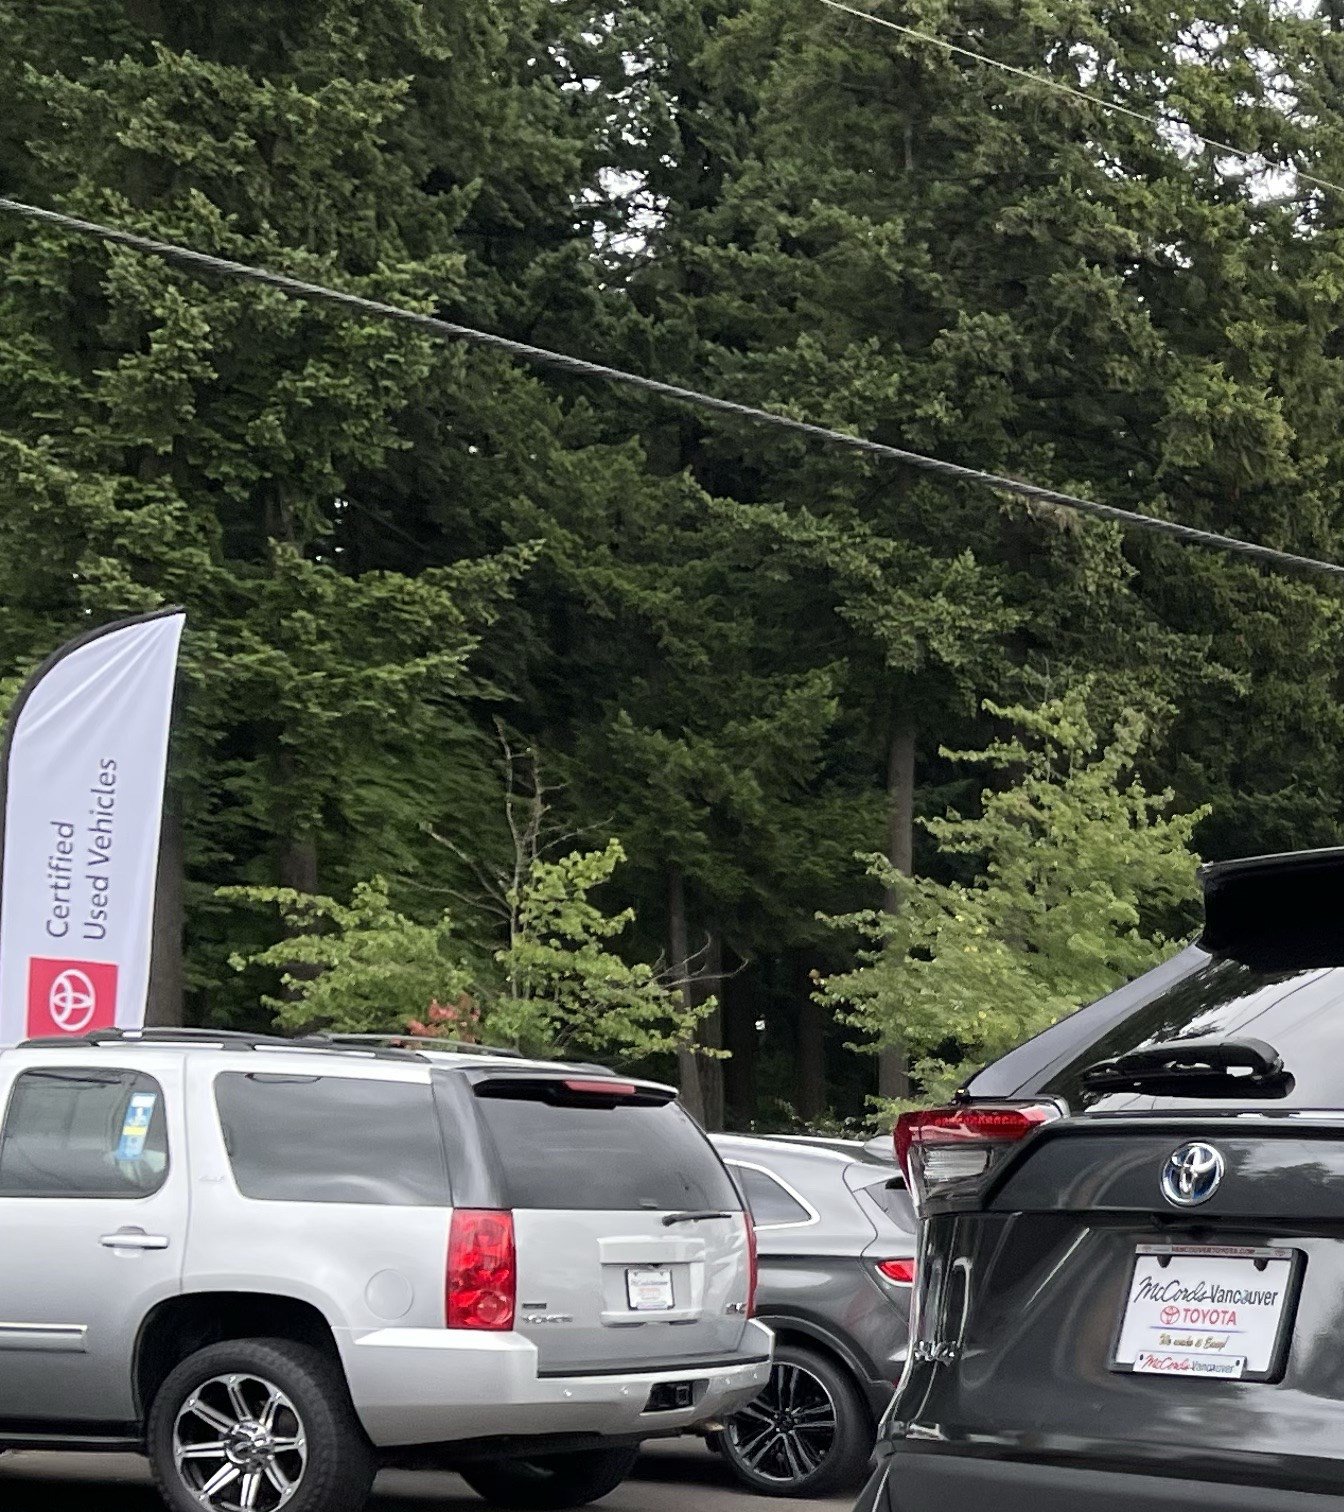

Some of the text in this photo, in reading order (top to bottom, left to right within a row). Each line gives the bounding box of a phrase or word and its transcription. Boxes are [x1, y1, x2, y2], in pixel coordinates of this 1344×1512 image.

[46, 820, 75, 938] Certified
[83, 758, 117, 940] Used Vehicles
[1182, 1308, 1238, 1326] TOYOTA
